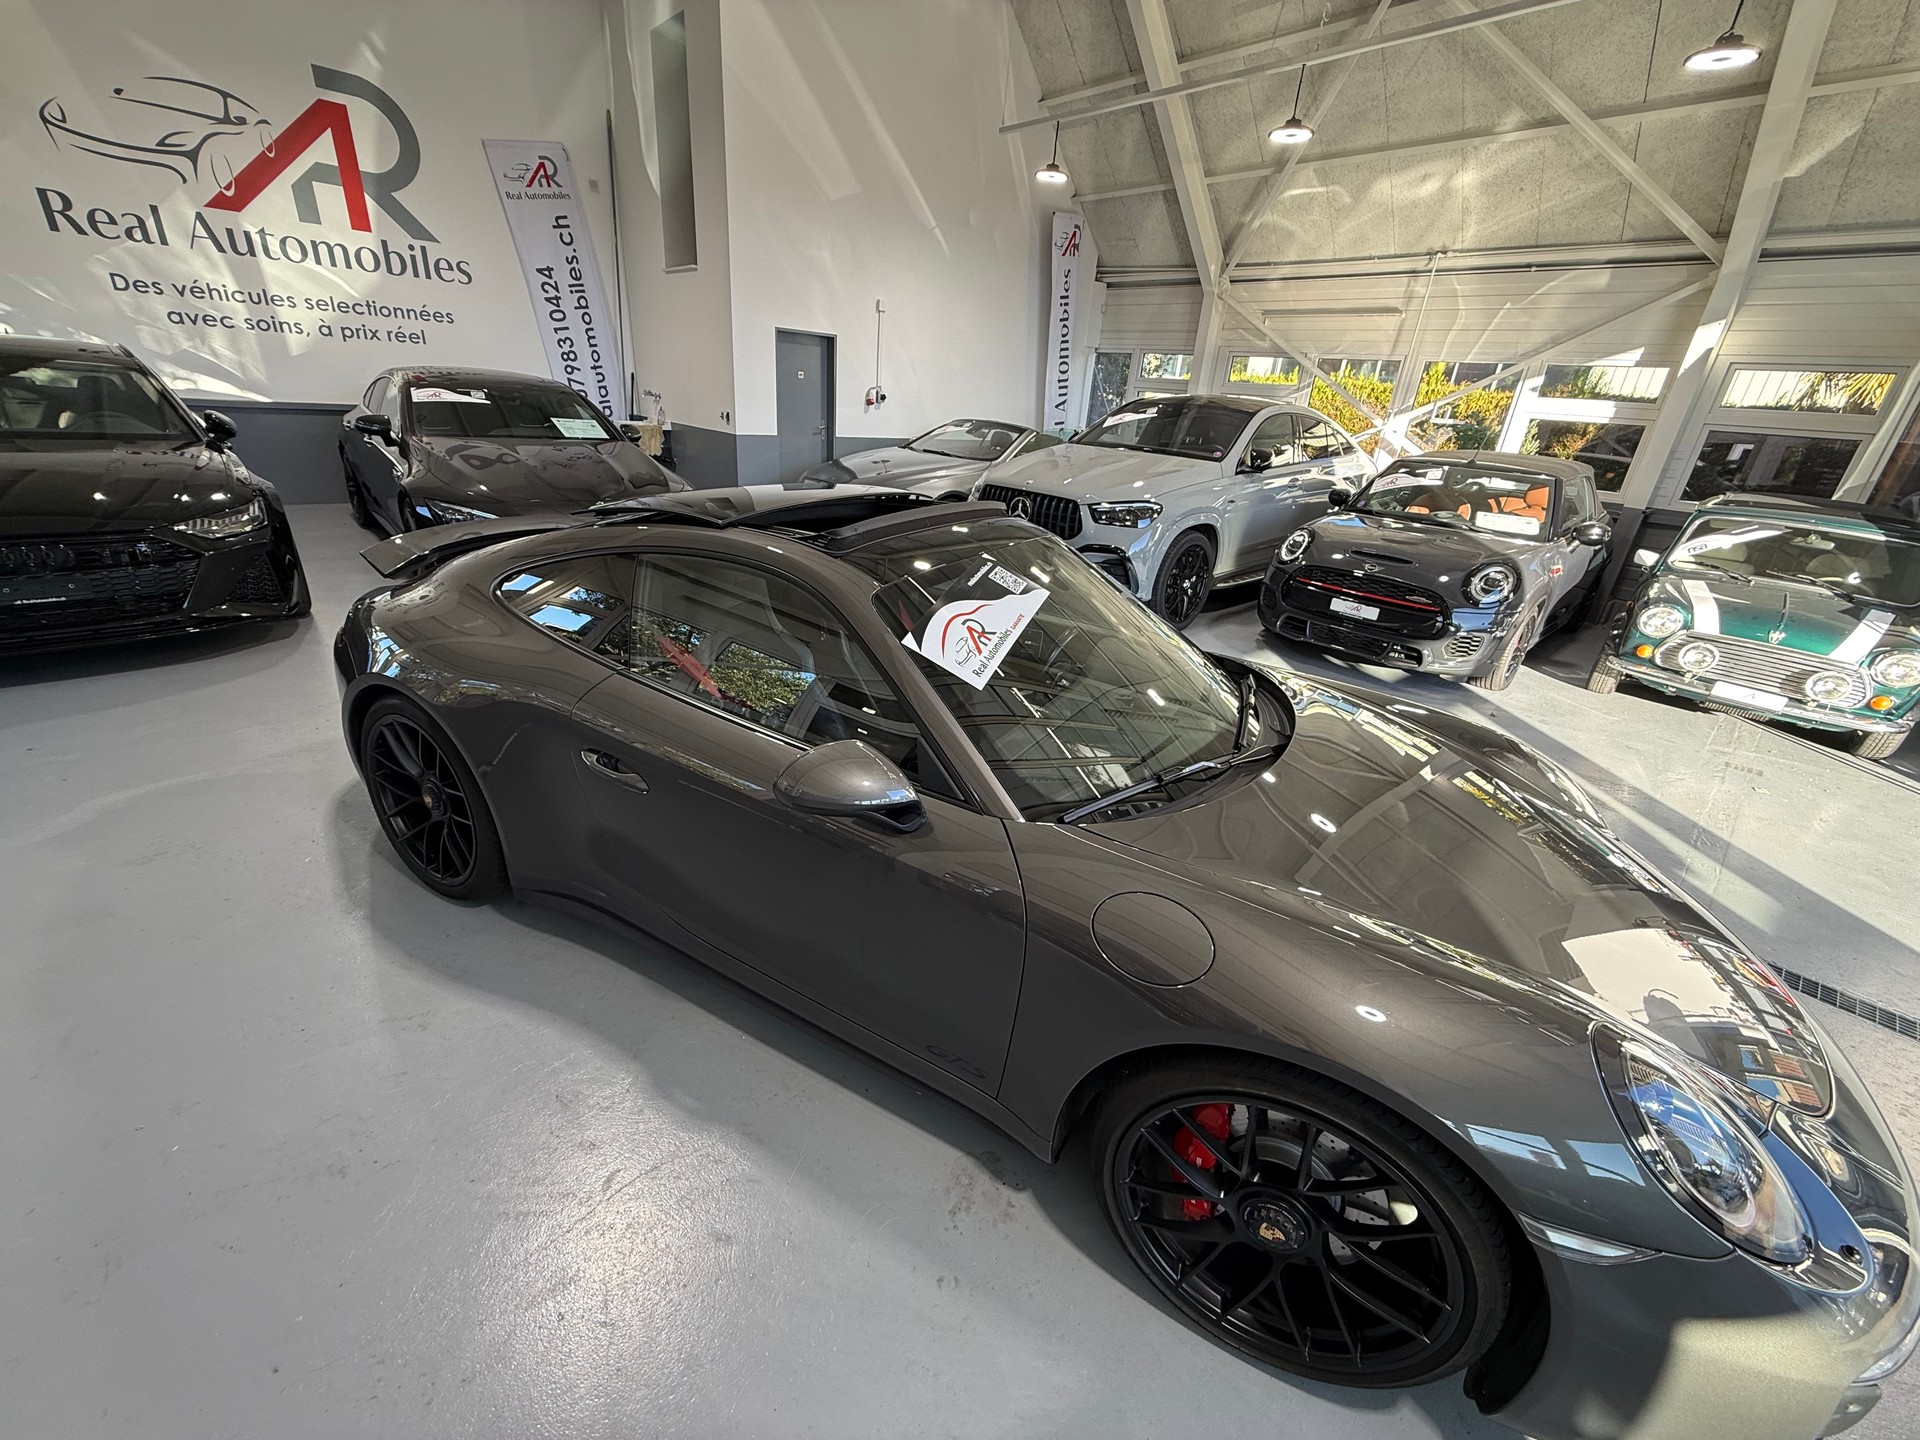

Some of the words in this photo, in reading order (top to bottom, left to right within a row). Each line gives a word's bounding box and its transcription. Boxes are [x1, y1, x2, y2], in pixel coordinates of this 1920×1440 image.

[505, 191, 523, 200] Real
[524, 191, 571, 201] Automobiles
[35, 187, 170, 247] Real
[190, 210, 473, 285] Automobiles
[108, 272, 165, 296] Des
[171, 279, 297, 309] véhicules
[304, 295, 455, 324] selectionnées
[552, 214, 614, 418] alautomobiles.ch
[167, 309, 236, 329] avec
[245, 315, 311, 338] soins,
[318, 318, 333, 337] à
[340, 324, 381, 342] prix
[386, 325, 427, 345] réel
[1053, 268, 1072, 412] Automobiles
[971, 659, 989, 678] Real
[983, 628, 1013, 664] Automobiles
[925, 1044, 988, 1080] GTS
